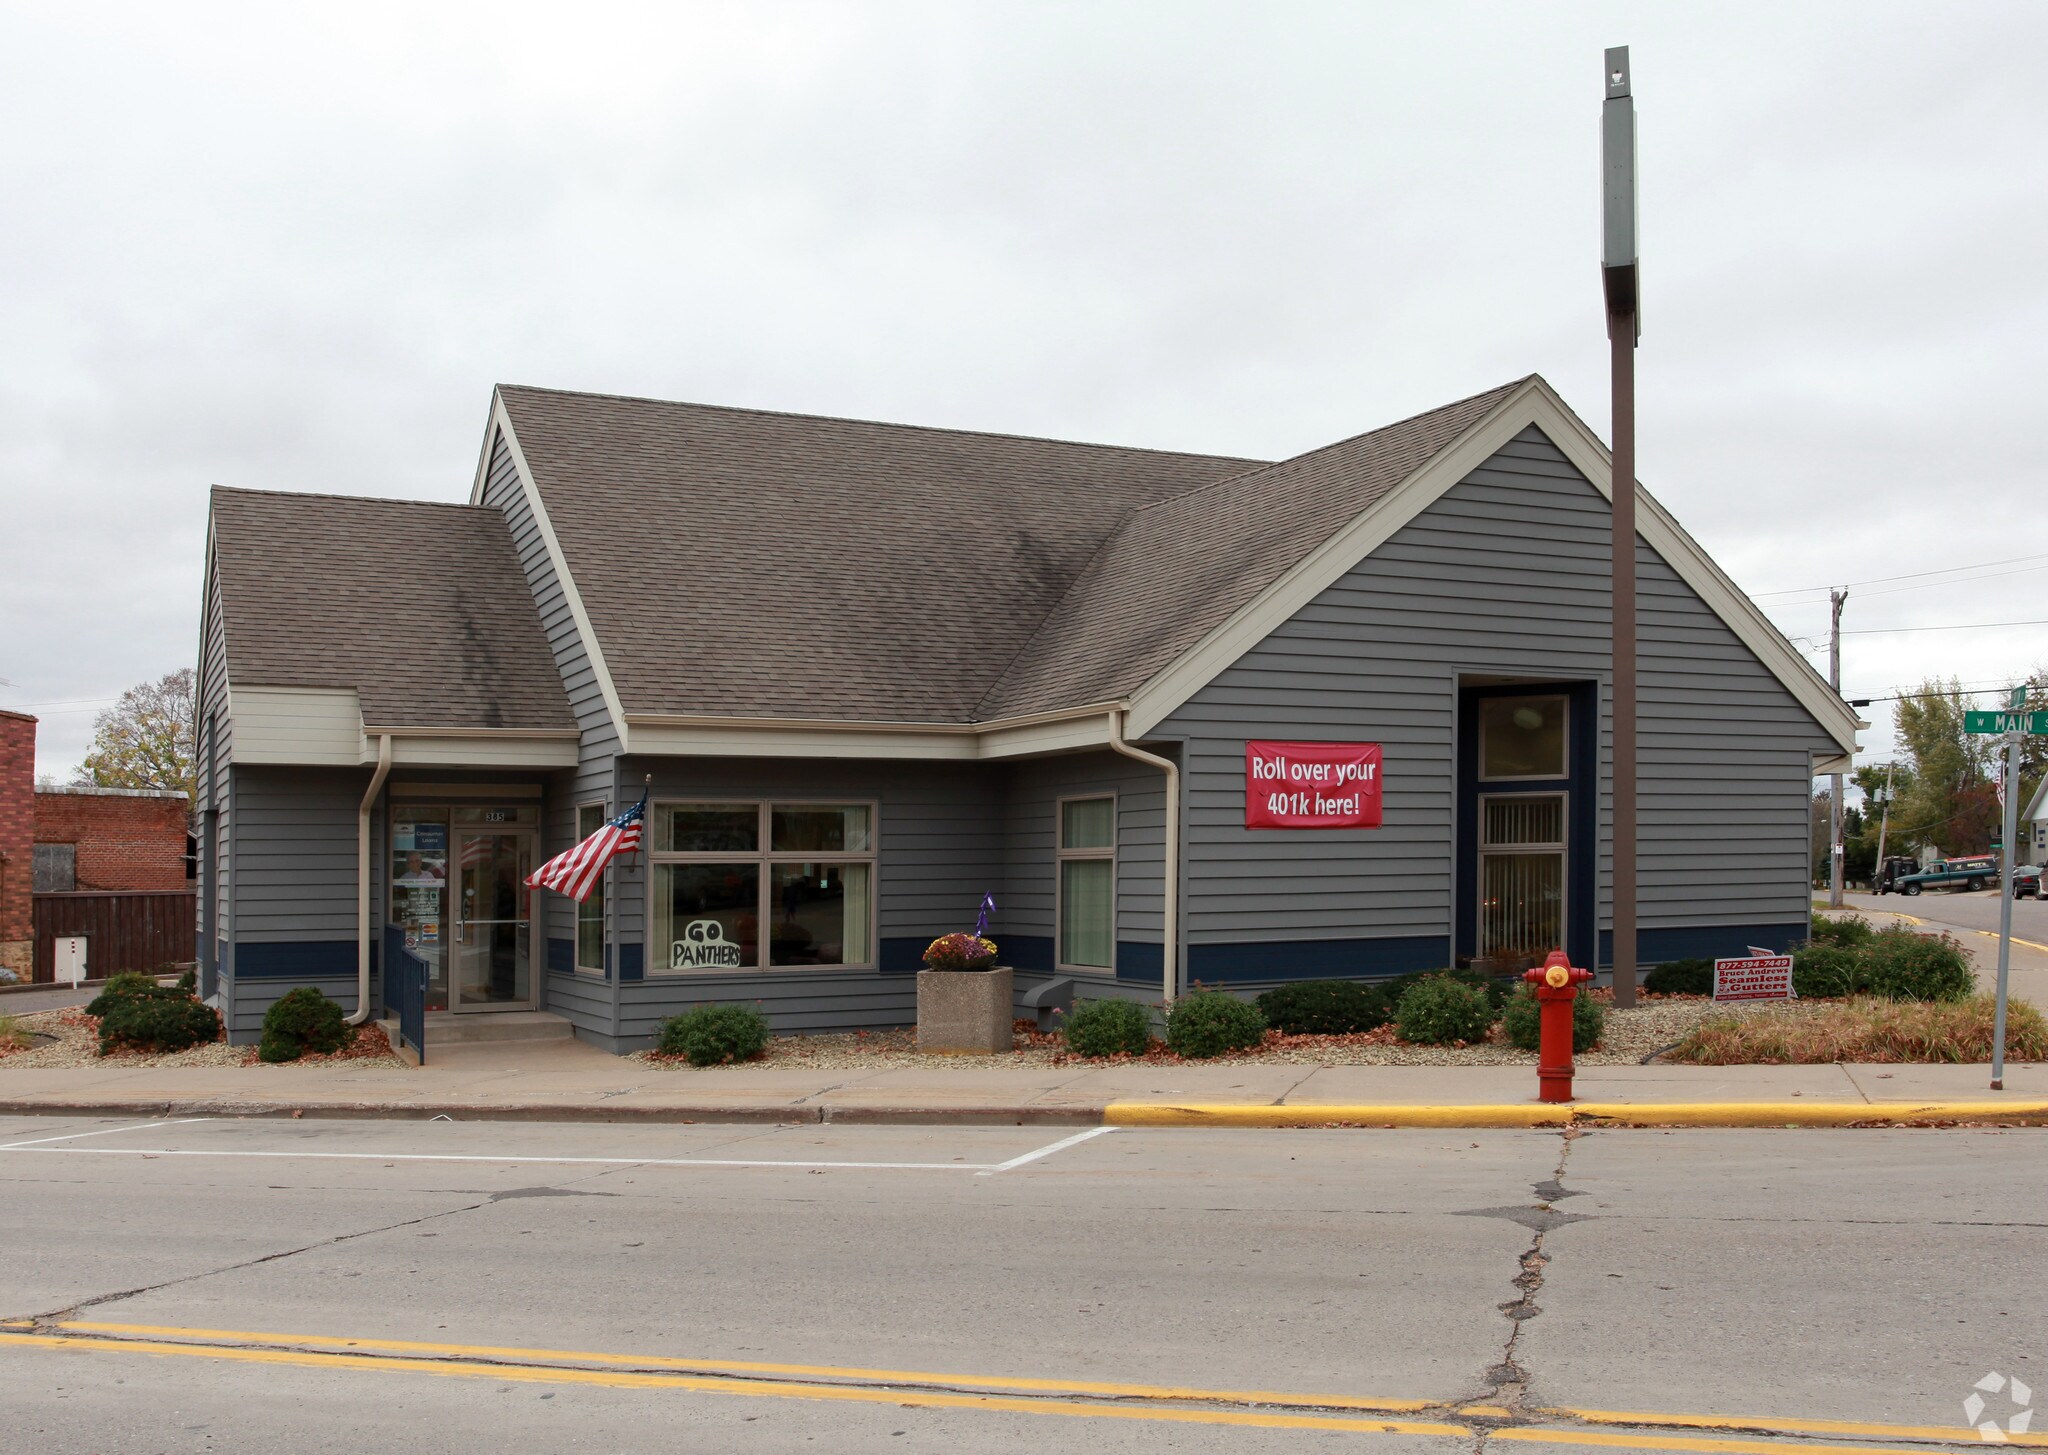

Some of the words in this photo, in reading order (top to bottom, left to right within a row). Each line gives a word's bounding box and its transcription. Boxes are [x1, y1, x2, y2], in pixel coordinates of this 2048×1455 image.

[1976, 718, 1985, 727] W
[1994, 714, 2034, 731] MAIN
[1252, 756, 1286, 780] Roll
[1291, 763, 1331, 781] over
[1335, 763, 1376, 786] your
[1267, 792, 1310, 815] 401k
[1314, 792, 1360, 815] here!
[486, 812, 505, 822] 385
[688, 922, 720, 943] GO
[673, 943, 741, 968] PANTHERS
[1719, 959, 1788, 970] 877-594-7449
[1719, 969, 1746, 977] Bruce
[1747, 968, 1789, 976] Andrews
[1718, 975, 1788, 985] Seamless
[1730, 982, 1787, 992] Gutters
